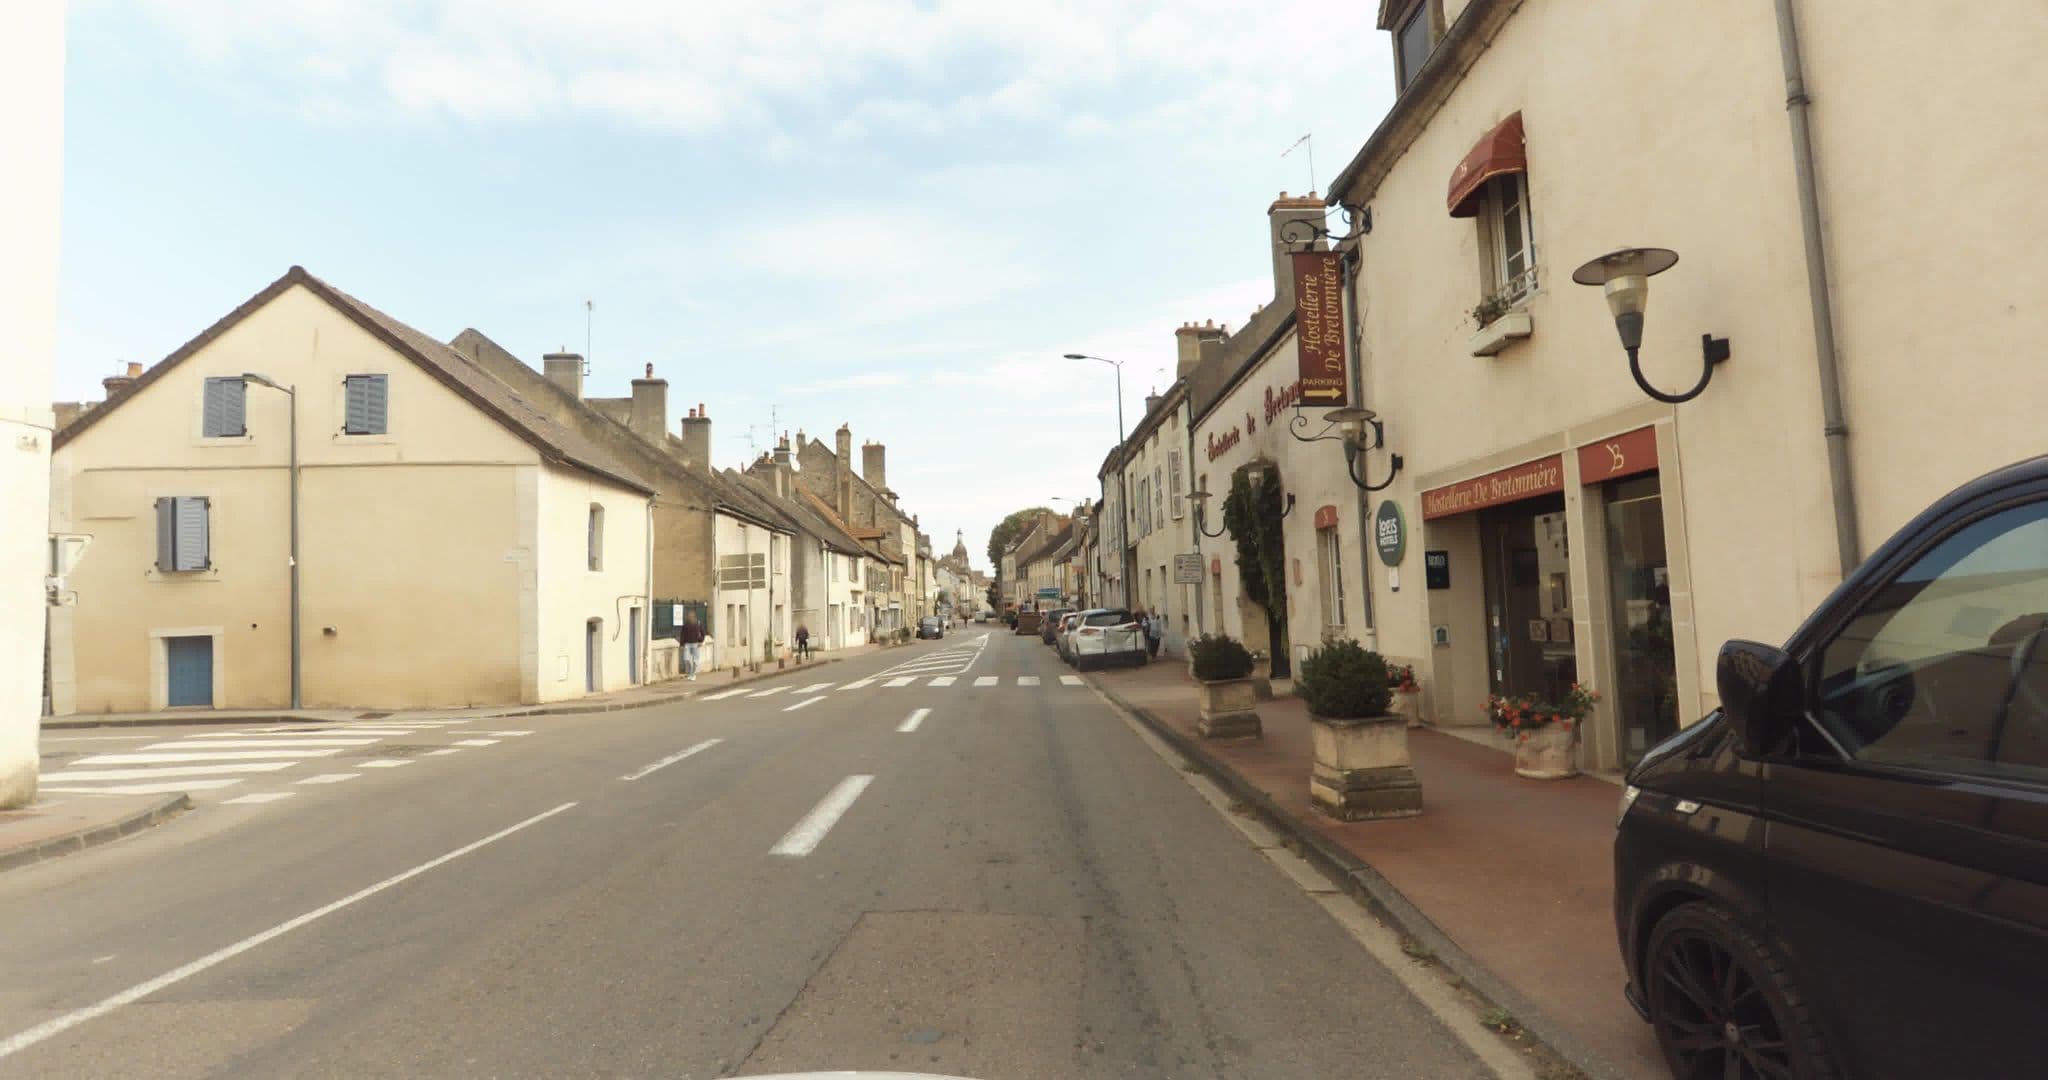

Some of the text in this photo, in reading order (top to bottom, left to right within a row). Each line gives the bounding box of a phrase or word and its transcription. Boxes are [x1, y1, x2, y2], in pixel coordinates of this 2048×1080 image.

[1300, 274, 1321, 355] Hostellerie
[1320, 257, 1341, 372] De Bretonnière
[1302, 377, 1343, 386] PARKING
[1426, 463, 1557, 514] Hostellerie De Bretonnière
